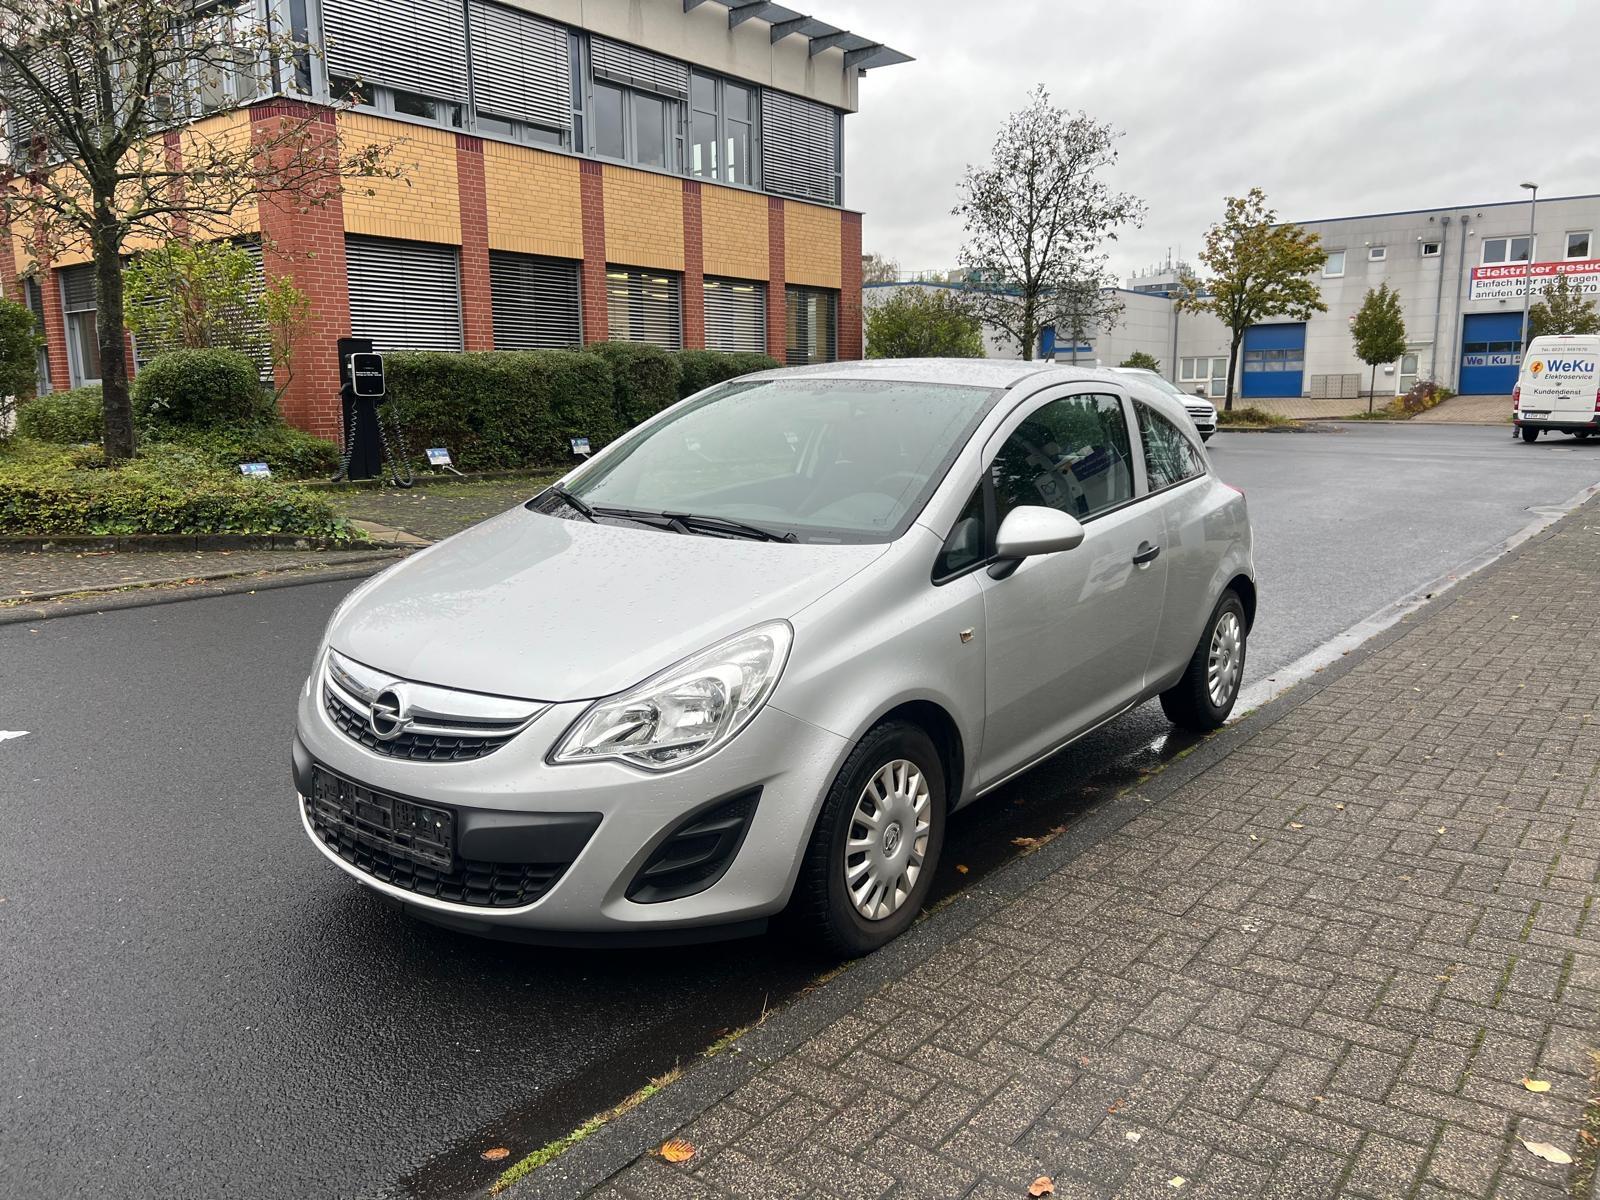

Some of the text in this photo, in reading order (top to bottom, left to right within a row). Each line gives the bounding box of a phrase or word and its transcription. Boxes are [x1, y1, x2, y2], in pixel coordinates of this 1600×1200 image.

[1476, 279, 1513, 289] Einfach
[1541, 274, 1598, 286] nacragen
[1475, 289, 1513, 299] anrufen
[1467, 356, 1483, 365] We
[1492, 355, 1506, 364] Ku
[1547, 359, 1595, 372] WeKu
